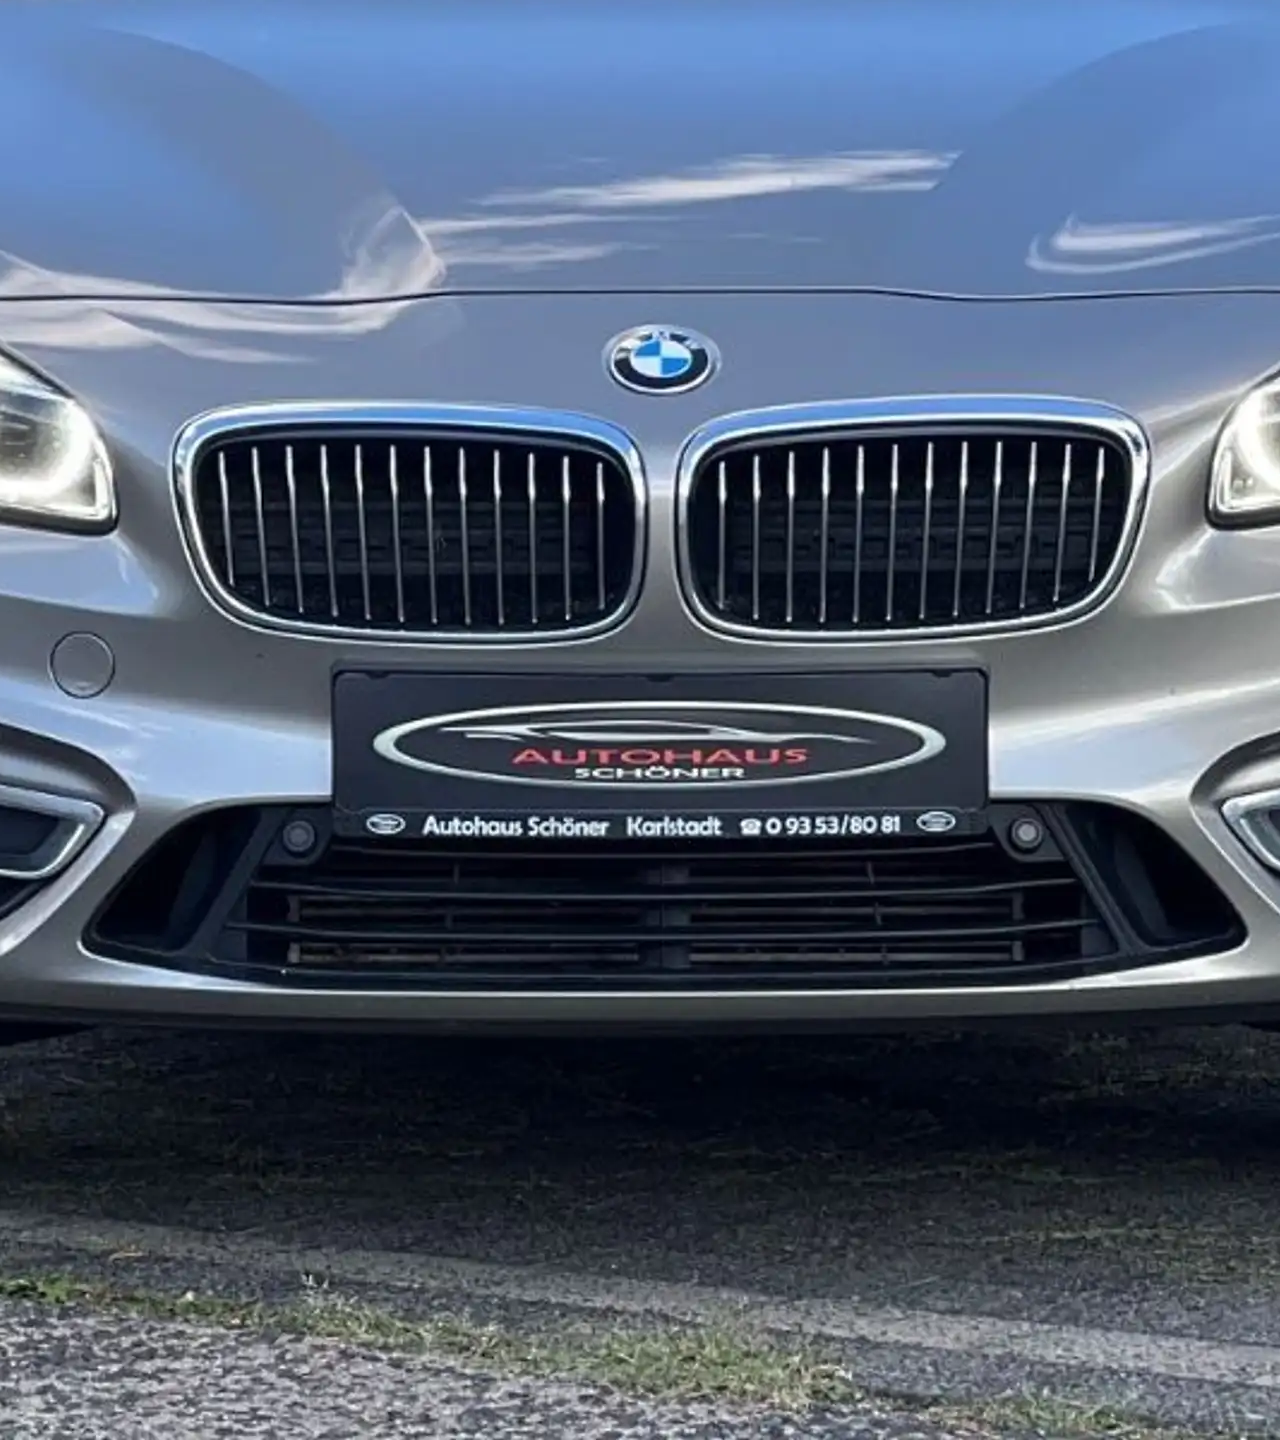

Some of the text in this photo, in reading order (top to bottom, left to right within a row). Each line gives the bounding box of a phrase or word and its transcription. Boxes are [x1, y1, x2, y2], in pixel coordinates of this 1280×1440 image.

[512, 748, 808, 765] AUTOHAUS
[574, 765, 746, 780] SCHÖNER
[422, 814, 523, 837] Autohaus
[527, 816, 610, 837] Schöner
[626, 816, 723, 837] Karlstadt
